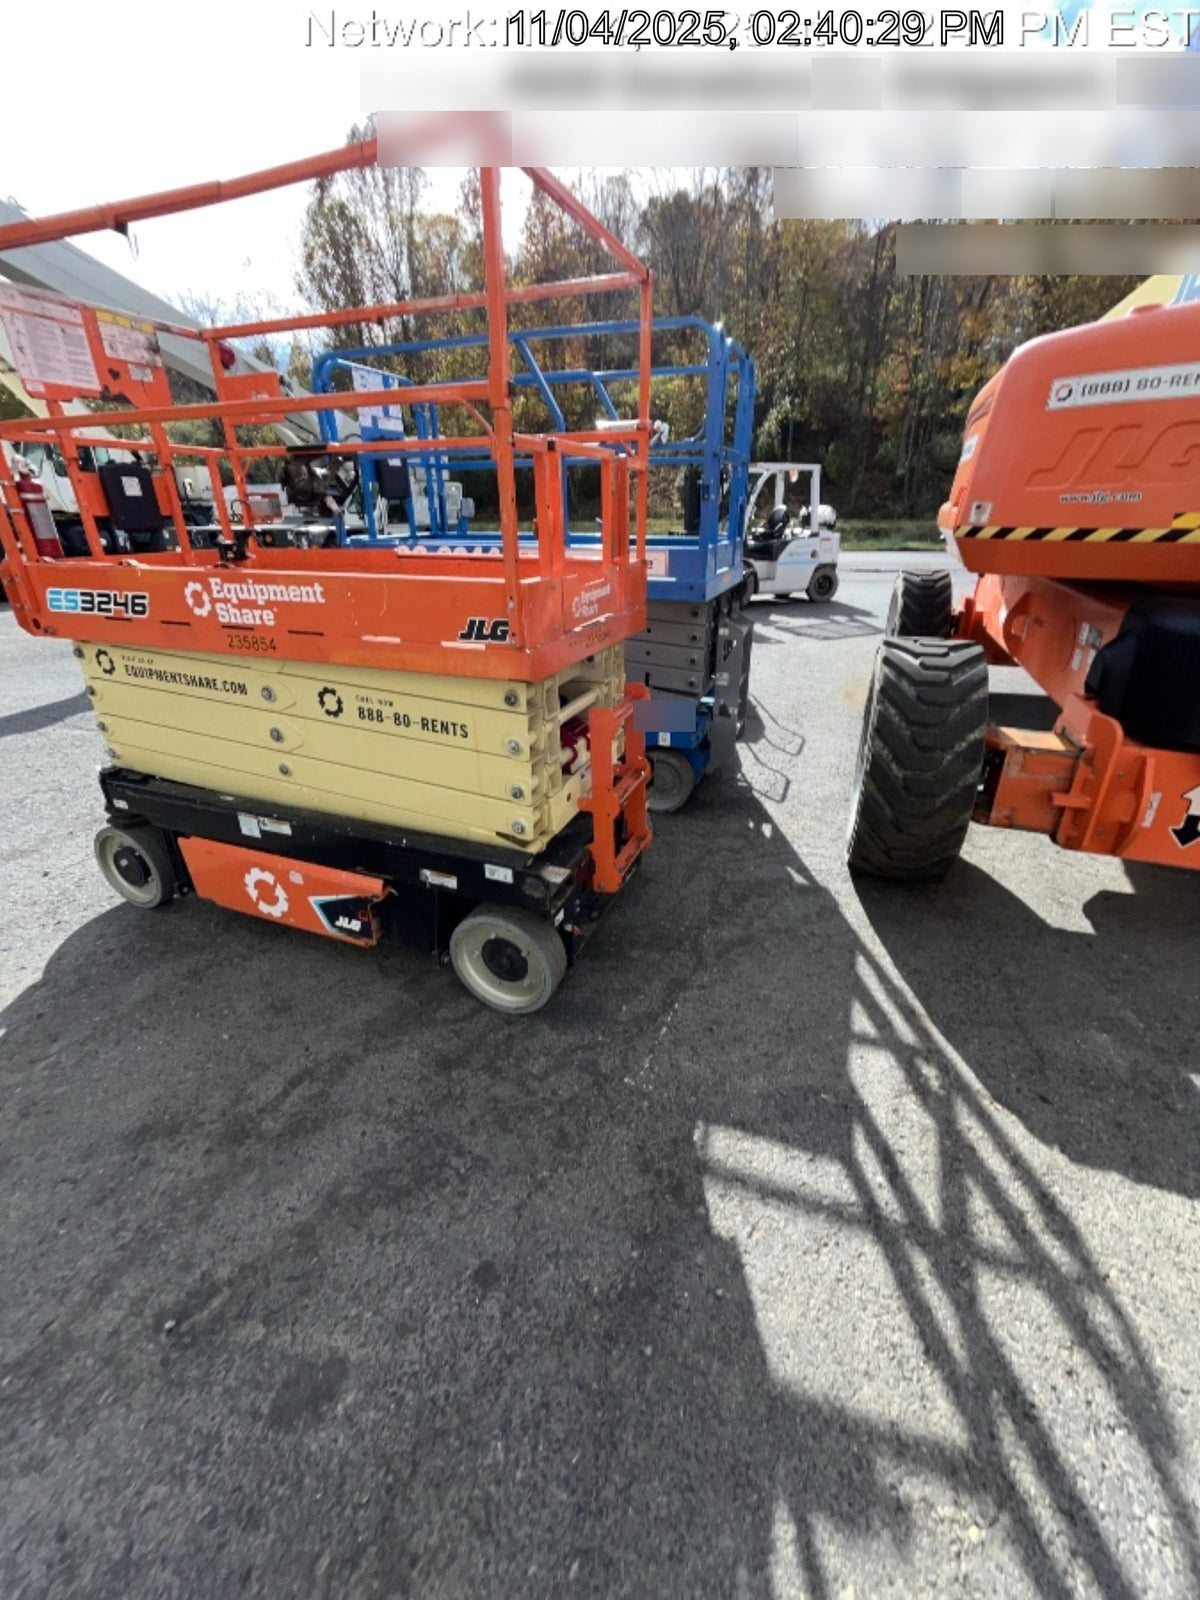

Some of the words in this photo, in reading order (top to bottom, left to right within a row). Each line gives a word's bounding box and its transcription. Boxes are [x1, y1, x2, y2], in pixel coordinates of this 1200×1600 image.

[1081, 378, 1131, 398] (888)
[47, 588, 149, 618] ES3246
[208, 578, 326, 603] Equipment
[217, 603, 276, 626] Share
[227, 633, 277, 652] 235854
[458, 616, 510, 644] JLG
[124, 664, 248, 696] EQUIPMENTSHARE.COM
[357, 706, 469, 739] 888-80-RENTS
